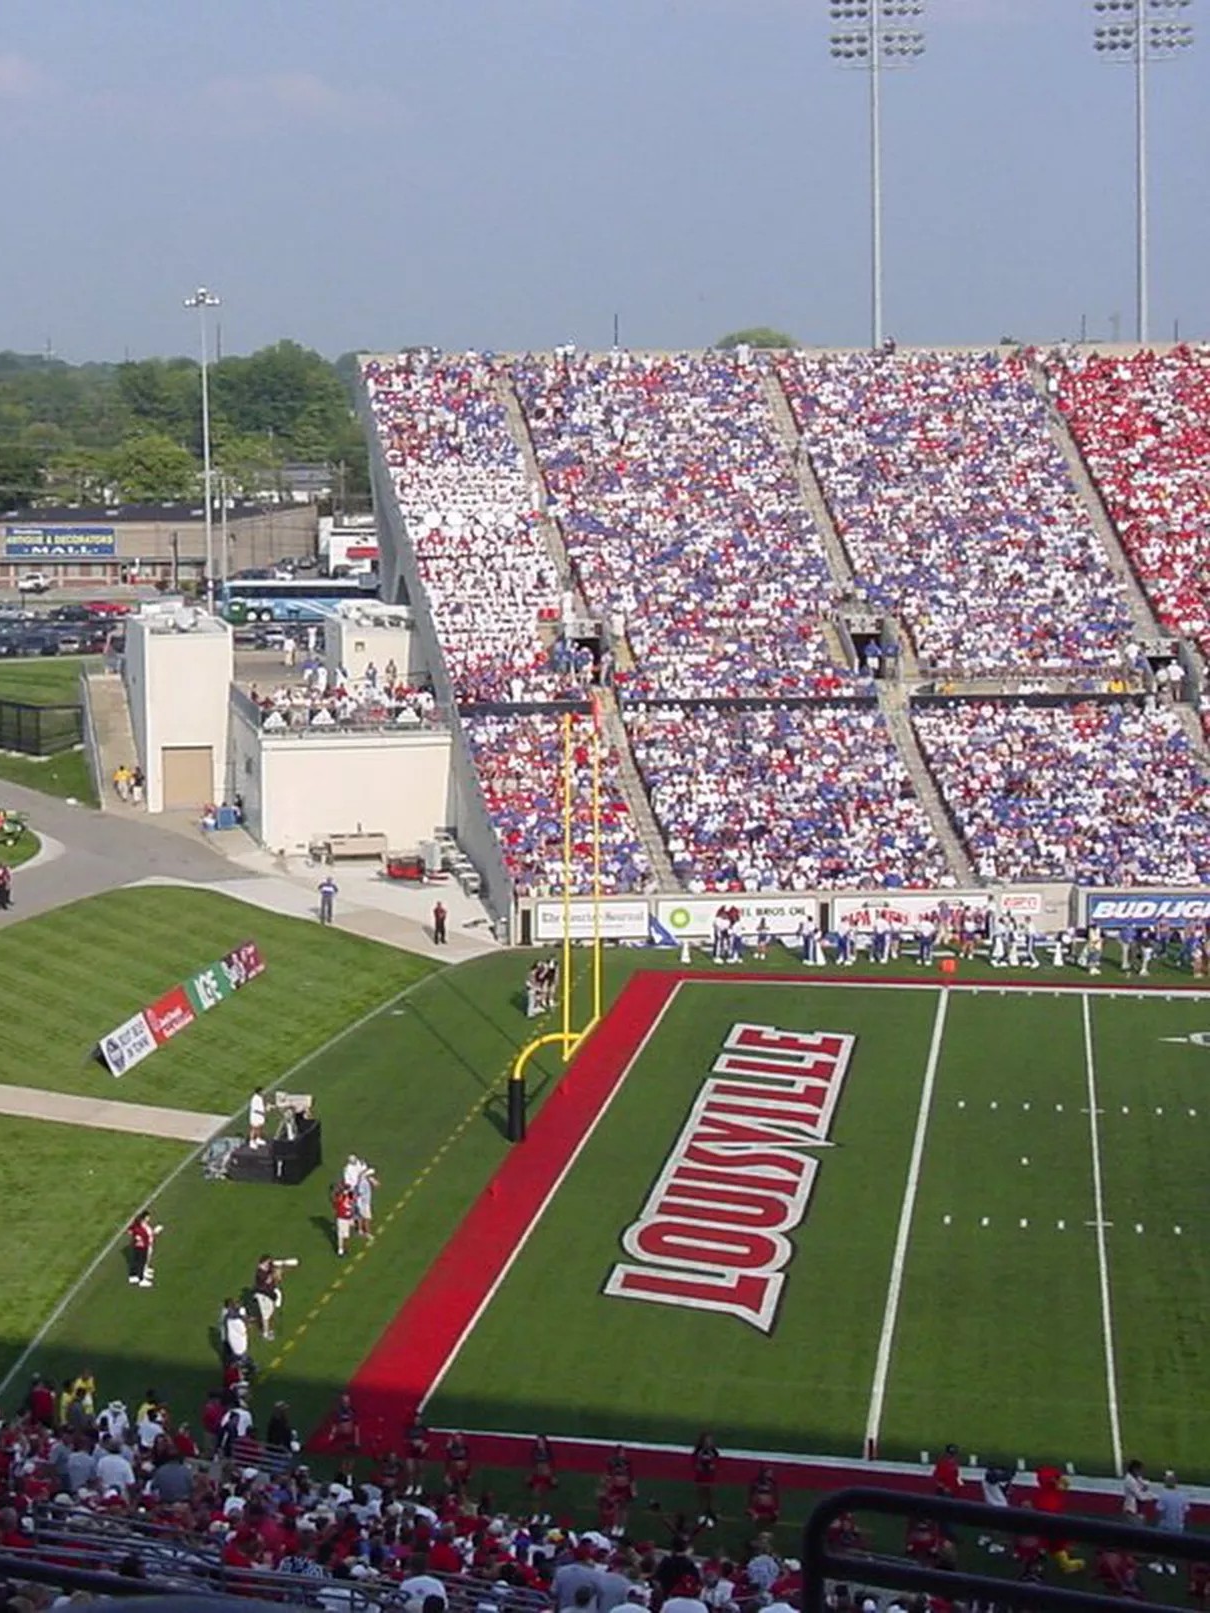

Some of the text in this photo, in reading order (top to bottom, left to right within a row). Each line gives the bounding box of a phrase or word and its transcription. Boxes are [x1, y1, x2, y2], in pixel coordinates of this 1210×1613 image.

[31, 546, 92, 555] MALL
[1092, 901, 1210, 918] BUD LIG
[601, 1022, 856, 1335] LOUISVILLE
